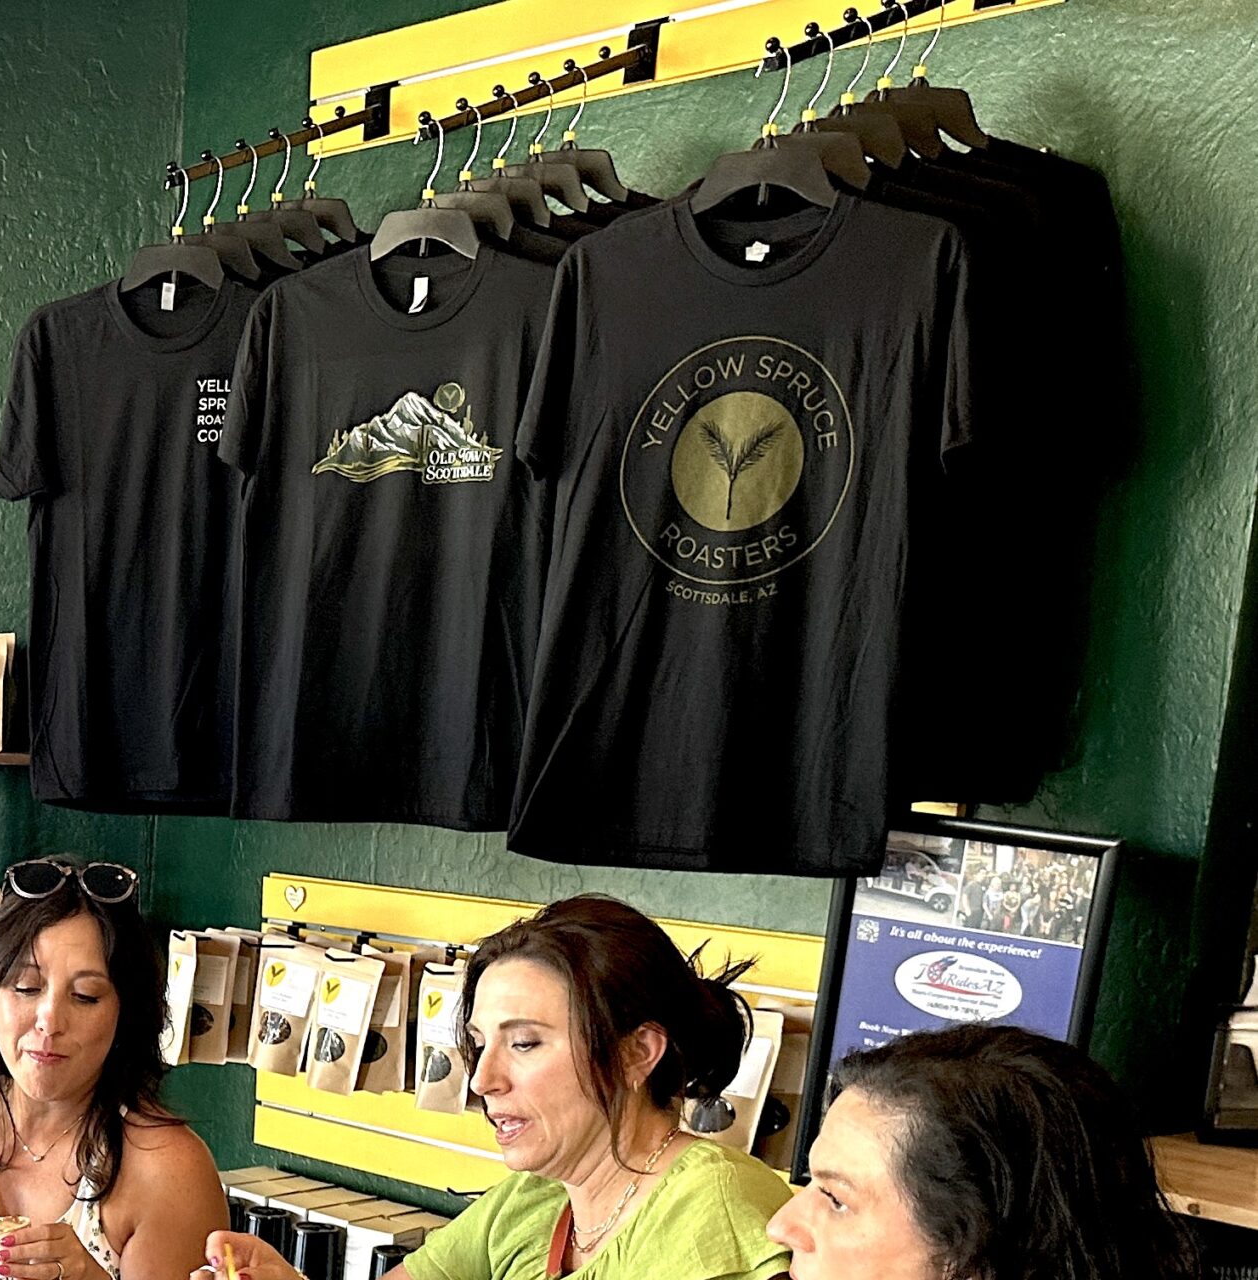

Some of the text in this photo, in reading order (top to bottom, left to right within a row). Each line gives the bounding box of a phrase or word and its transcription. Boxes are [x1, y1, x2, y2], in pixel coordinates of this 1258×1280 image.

[197, 379, 231, 392] YELL
[198, 397, 227, 411] SPR
[642, 354, 838, 451] YELLOW SPRUCE
[197, 429, 223, 442] CO
[429, 447, 491, 465] OLD TOWN
[660, 523, 797, 569] ROASTERS
[665, 580, 778, 605] SCOTTSDALE, AZ
[889, 926, 1042, 959] It's all about the experience!
